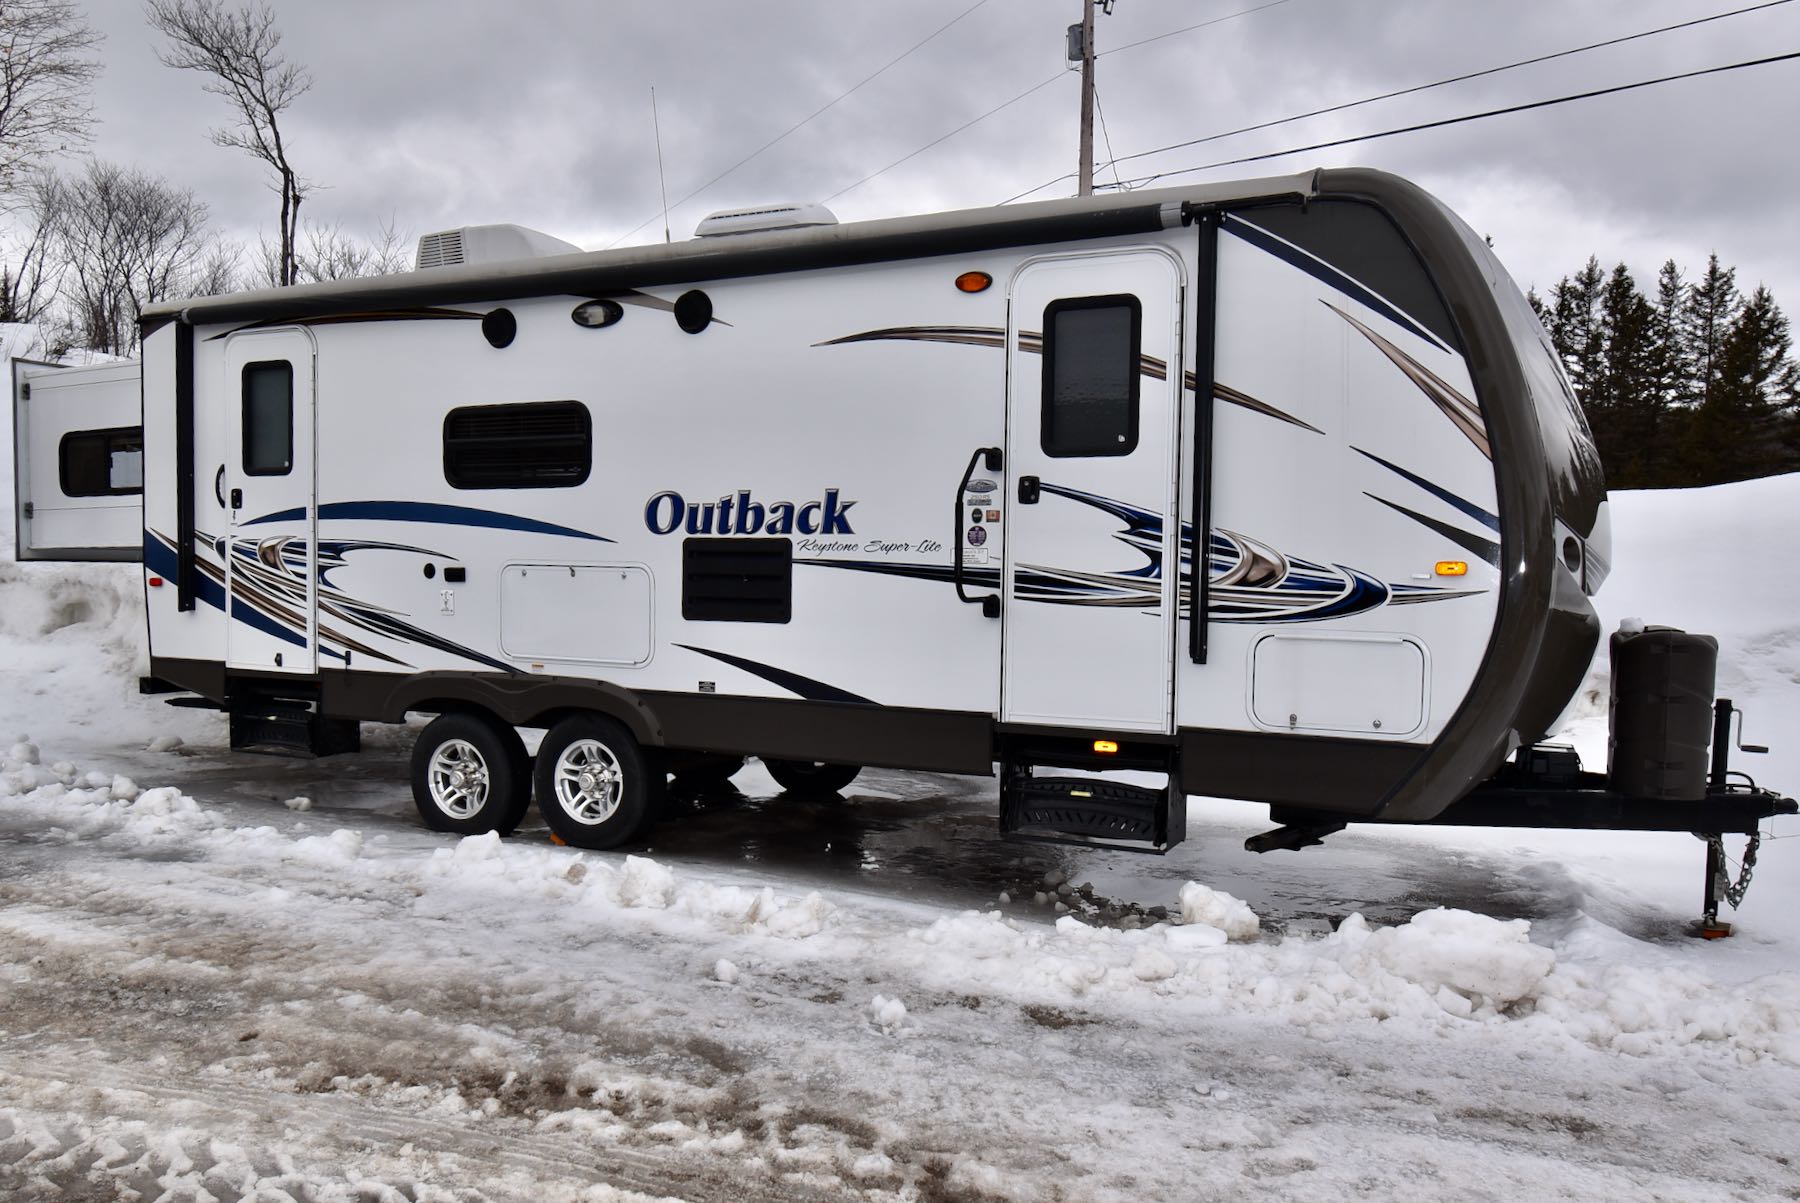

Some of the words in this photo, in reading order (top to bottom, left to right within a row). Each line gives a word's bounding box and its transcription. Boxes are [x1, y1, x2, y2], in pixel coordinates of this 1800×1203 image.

[645, 488, 858, 535] Outback
[796, 539, 859, 557] Keystone
[863, 539, 943, 554] Super-Lite
